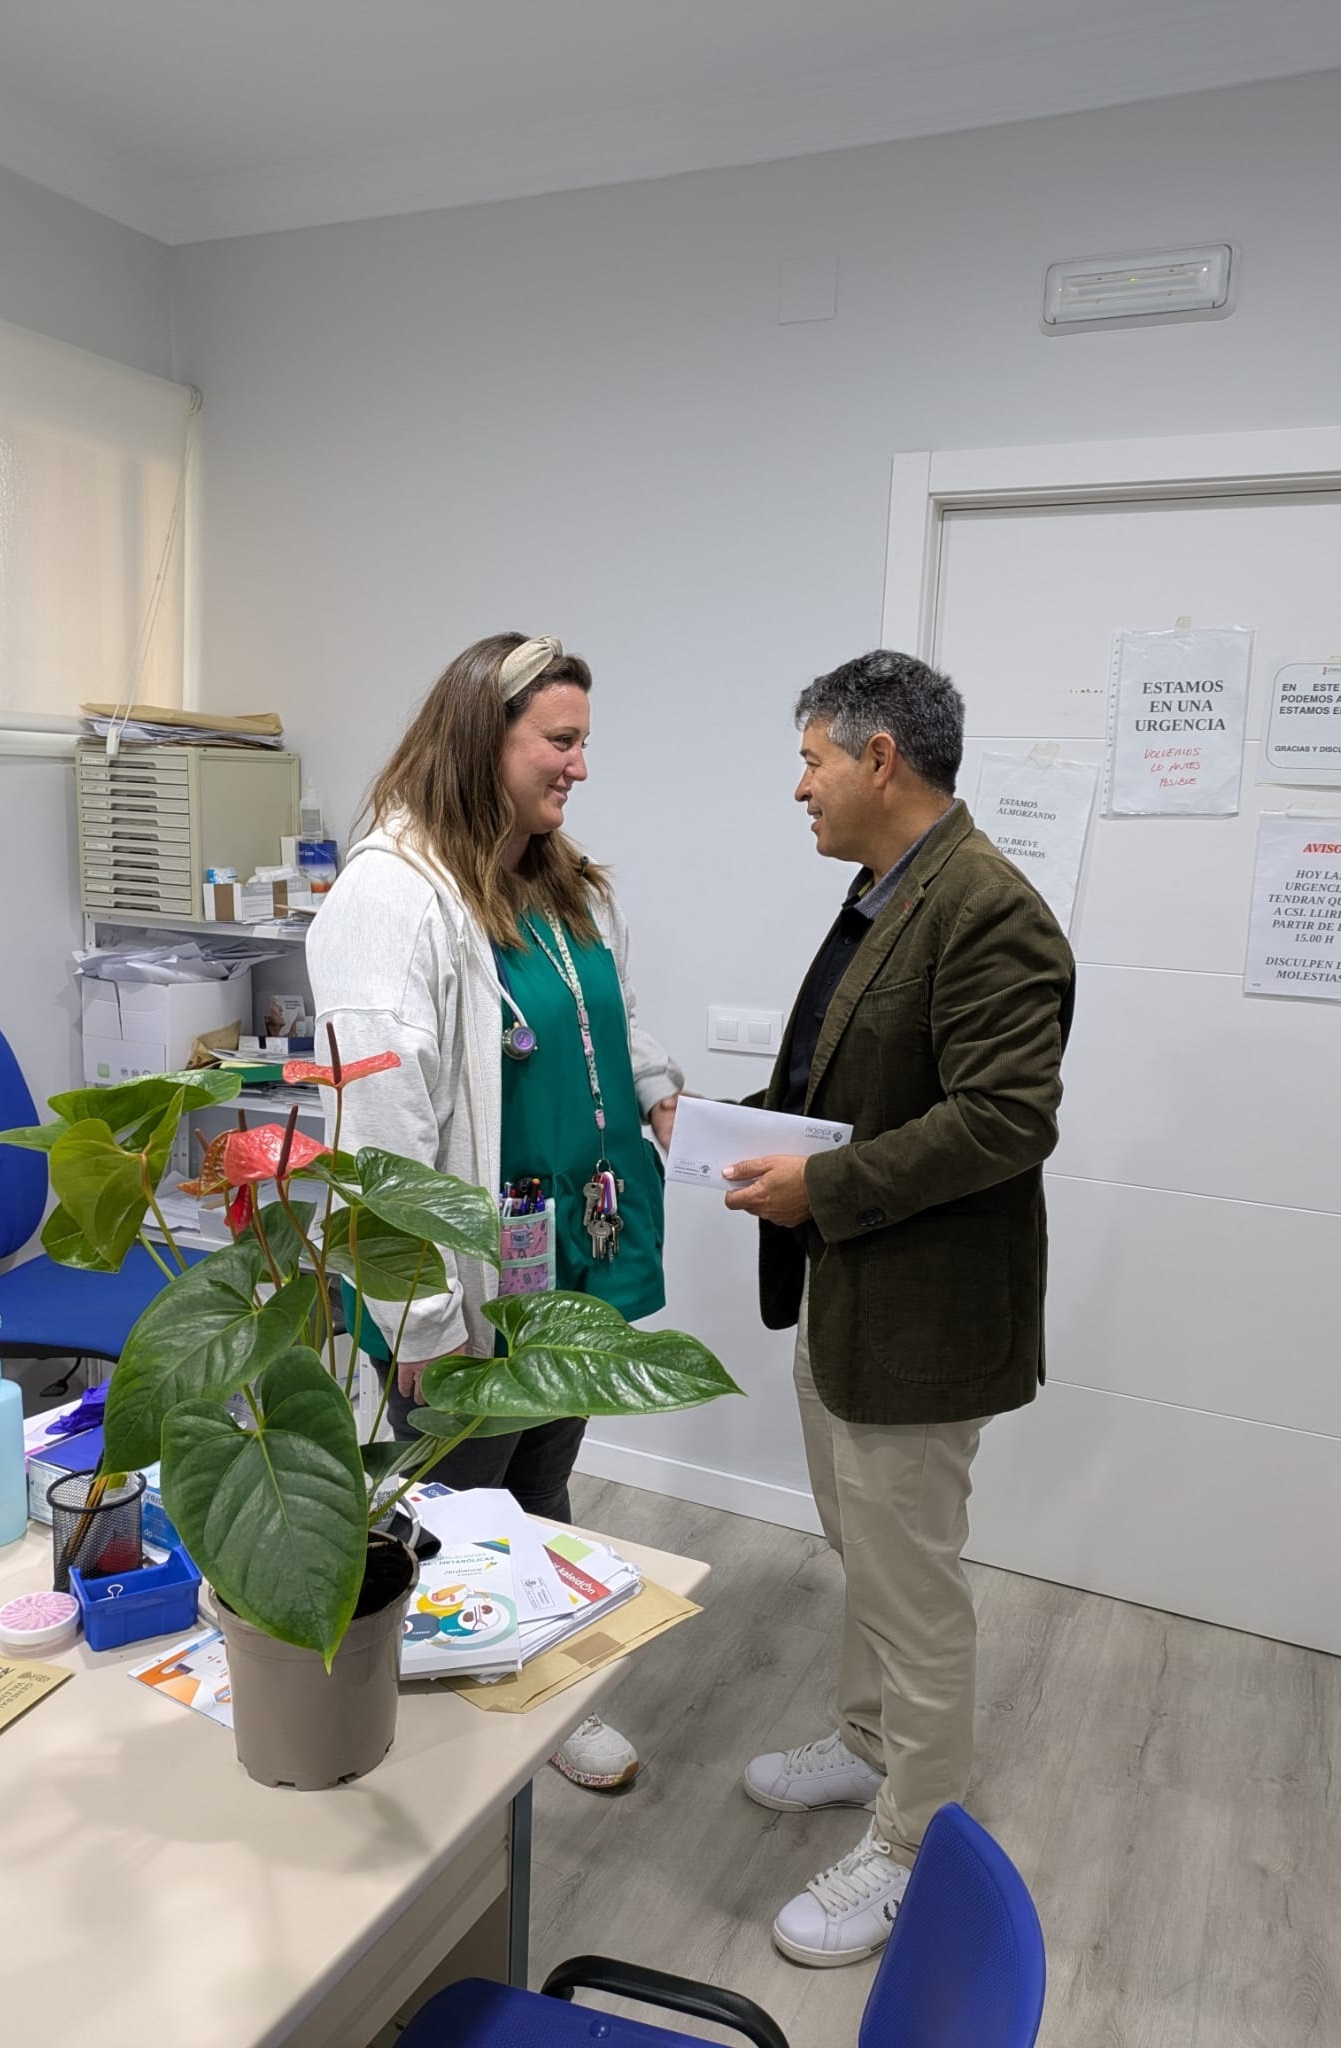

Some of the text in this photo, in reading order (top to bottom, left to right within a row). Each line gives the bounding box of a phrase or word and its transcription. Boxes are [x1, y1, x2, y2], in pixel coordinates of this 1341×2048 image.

[1142, 679, 1224, 694] ESTAMOS
[1281, 683, 1341, 692] EN ESTE
[1280, 694, 1334, 703] PODEMOS
[1149, 699, 1213, 713] EN UNA
[1279, 706, 1331, 715] ESTAMOS
[1135, 718, 1226, 732] URGENCIA
[1274, 745, 1311, 753] GRACIAS
[1312, 745, 1319, 753] Y
[1168, 761, 1201, 772] ANTES
[999, 797, 1039, 809] ESTAMOS
[996, 807, 1057, 821] ALMORZANDO
[997, 836, 1039, 848] EN BREVE
[997, 846, 1047, 859] GRESAMOS
[1295, 869, 1322, 879] HOY
[1268, 894, 1326, 905] TENDRAN
[1273, 907, 1283, 916] A
[1272, 919, 1314, 931] PARTIR
[1317, 921, 1335, 932] DE
[1295, 933, 1335, 944] 15.00 H
[1265, 956, 1334, 970] DISCULPEN
